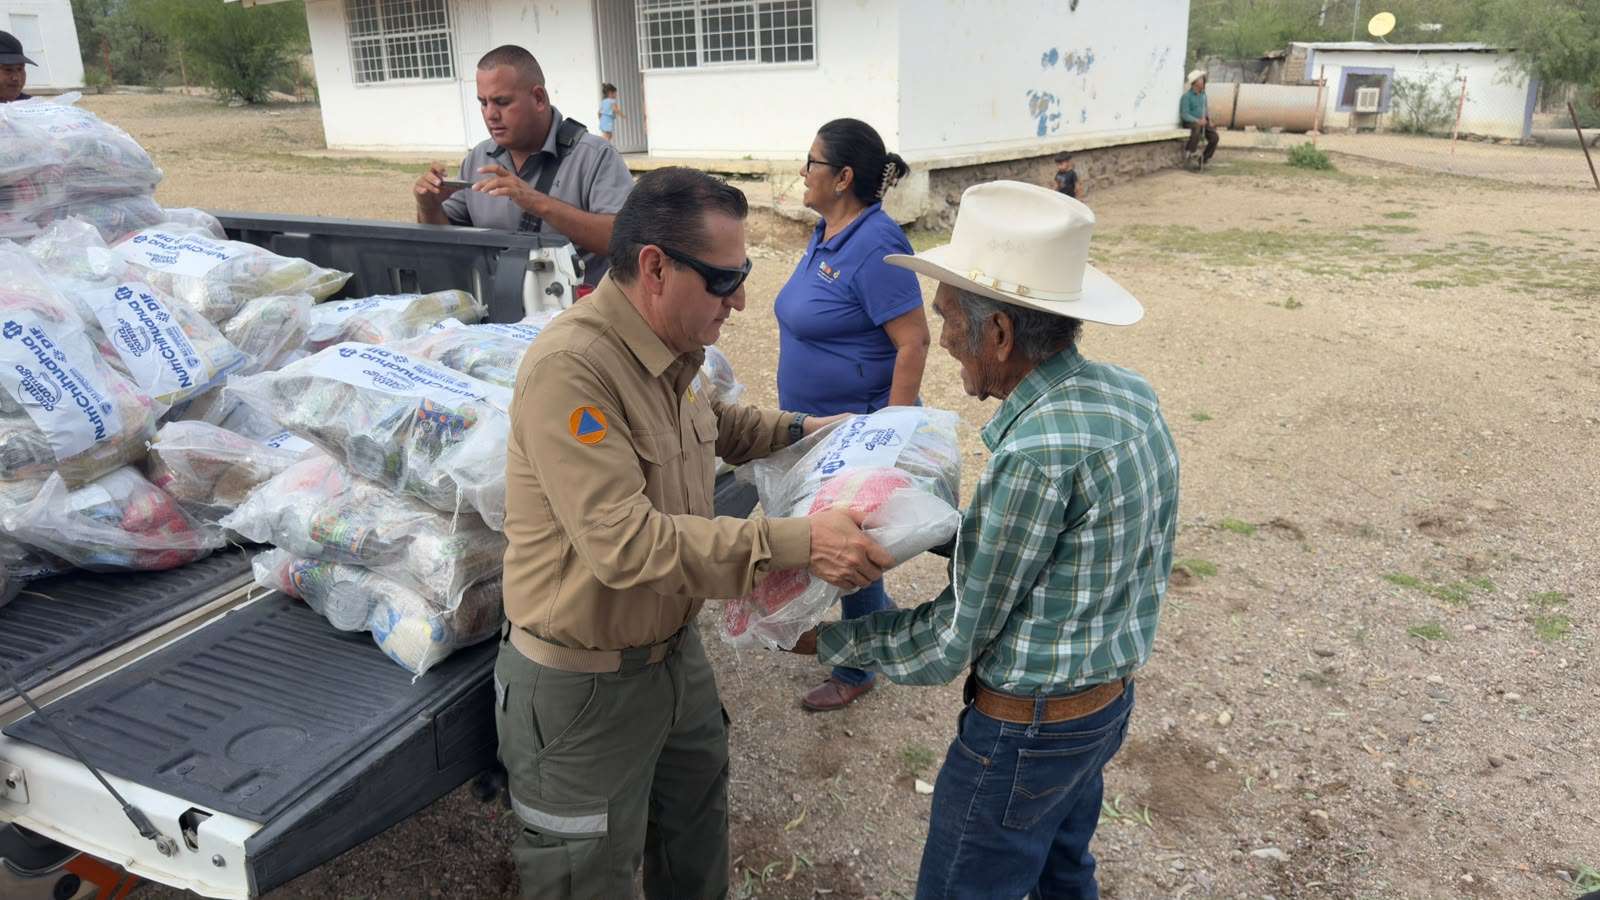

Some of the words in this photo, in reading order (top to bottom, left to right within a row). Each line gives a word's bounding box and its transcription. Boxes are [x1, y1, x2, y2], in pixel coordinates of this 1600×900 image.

[140, 292, 160, 311] DIF
[29, 327, 54, 349] DIF
[128, 300, 192, 388] NutriChihuahua
[15, 364, 56, 404] conmigo
[21, 336, 106, 440] NutriChihuahua
[21, 379, 54, 412] cuenta
